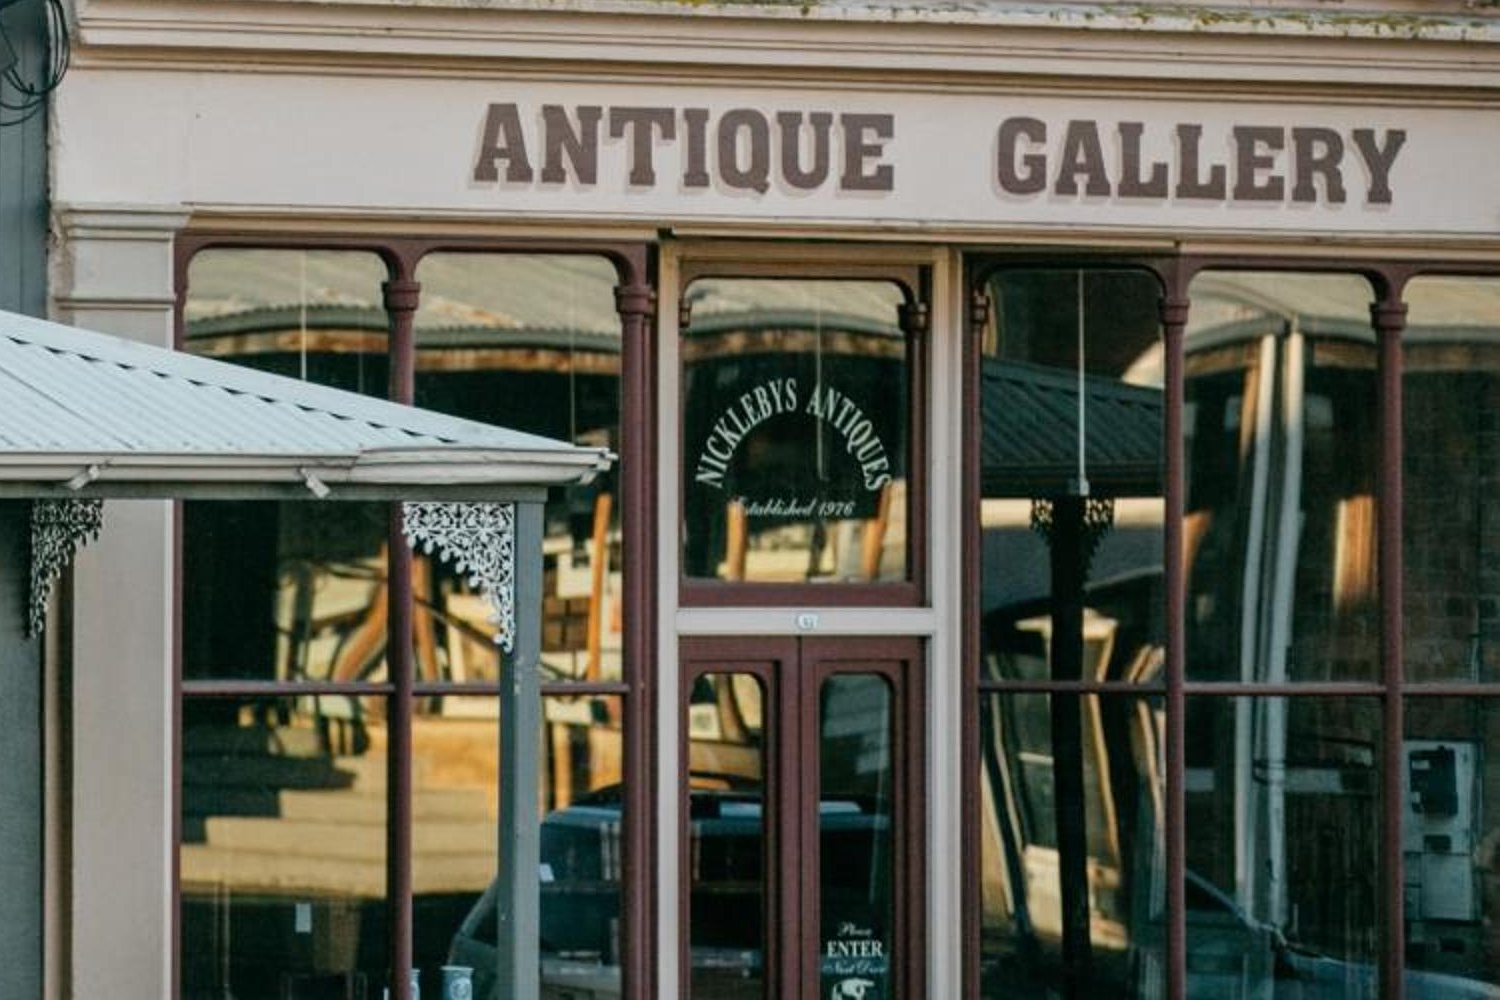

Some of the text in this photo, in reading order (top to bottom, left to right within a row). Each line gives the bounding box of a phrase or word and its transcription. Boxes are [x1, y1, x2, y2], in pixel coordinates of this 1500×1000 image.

[471, 103, 1408, 205] ANTIQUE GALLERY
[694, 377, 893, 491] NICKLEBYS ANTIQUES
[827, 940, 883, 958] ENTER
